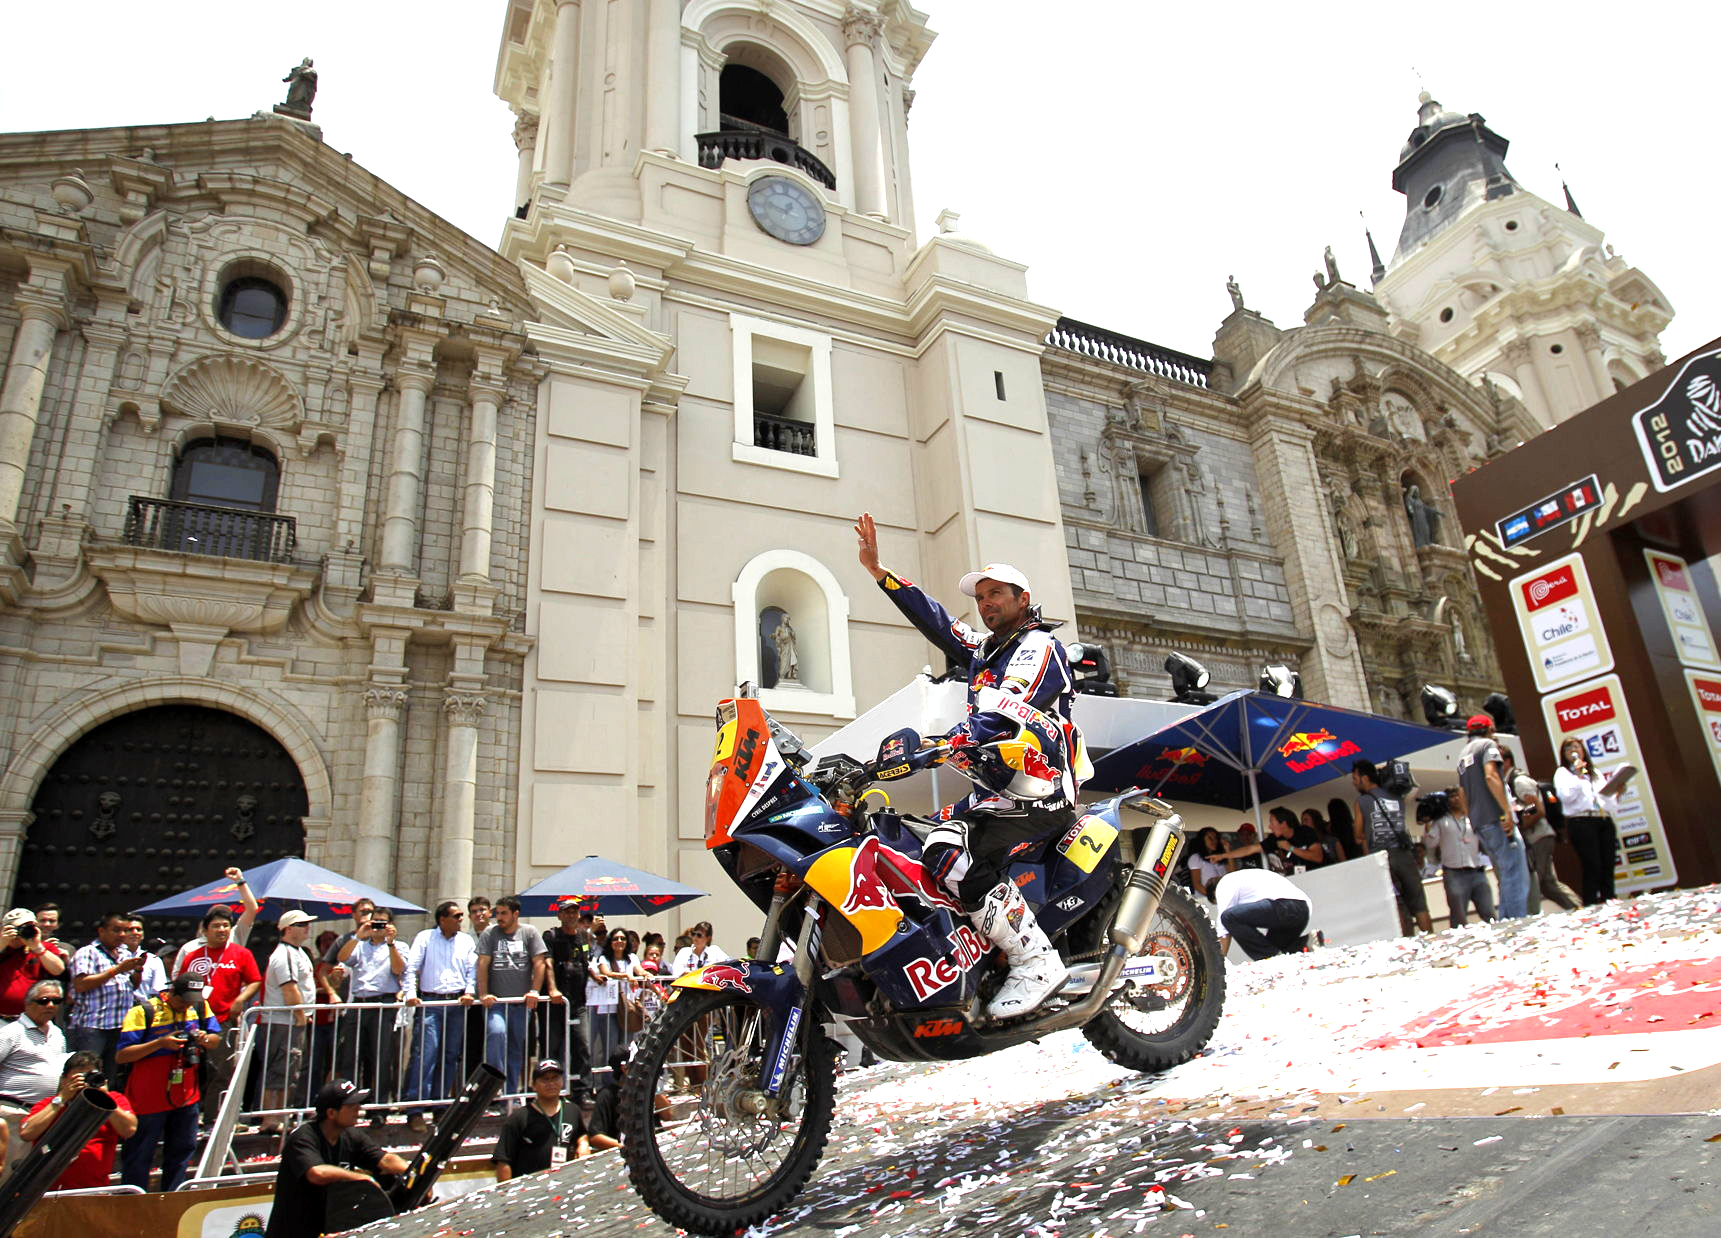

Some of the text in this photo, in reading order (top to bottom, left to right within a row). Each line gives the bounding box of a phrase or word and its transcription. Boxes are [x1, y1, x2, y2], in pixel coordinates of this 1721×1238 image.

[1650, 412, 1684, 475] 2012
[1542, 622, 1573, 641] Chile
[1559, 701, 1612, 721] TOTAL
[733, 727, 761, 782] KTM
[1066, 816, 1090, 842] TOTA
[1080, 835, 1103, 853] 2
[1120, 967, 1153, 977] ICHELIN
[1001, 999, 1022, 1007] TCX
[914, 1019, 964, 1038] KTM
[778, 1012, 800, 1070] MICHELIN
